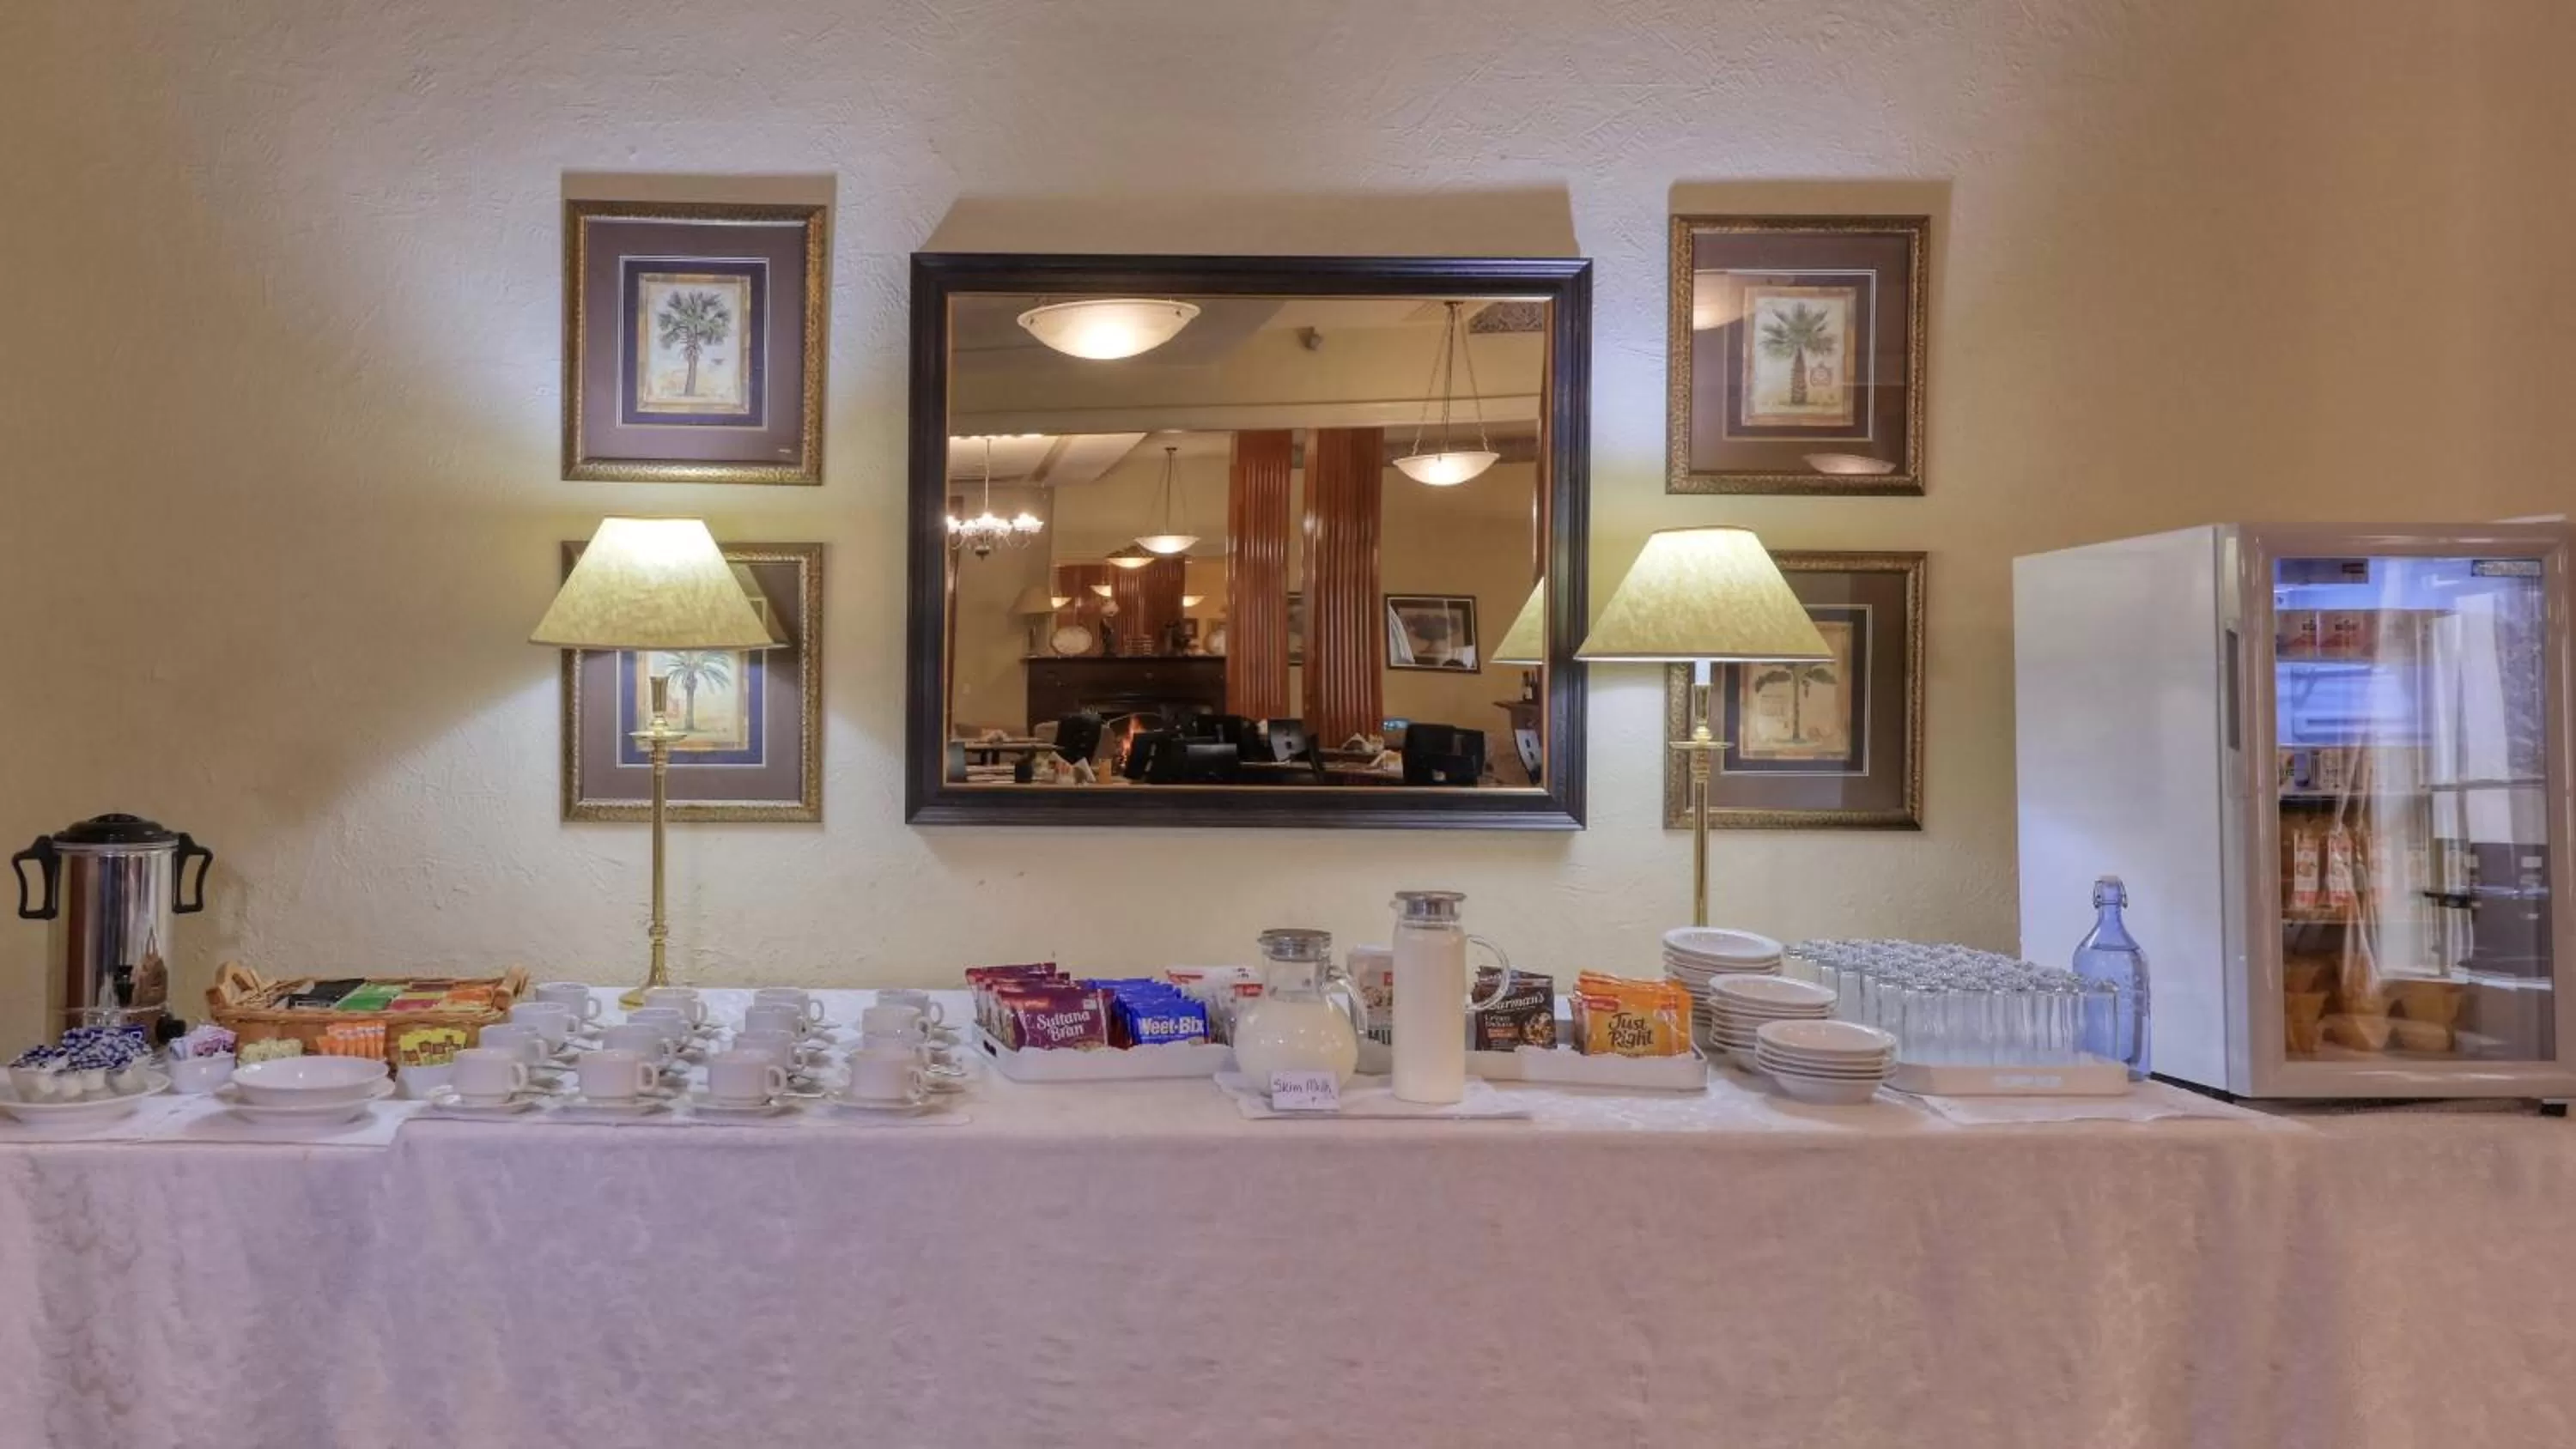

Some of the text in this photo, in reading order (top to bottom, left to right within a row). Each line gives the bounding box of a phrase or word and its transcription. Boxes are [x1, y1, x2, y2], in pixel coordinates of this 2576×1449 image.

[1036, 1011, 1091, 1031] Sultana
[1607, 1012, 1647, 1031] Just
[1047, 1024, 1084, 1041] Bran
[1607, 1030, 1655, 1048] Right
